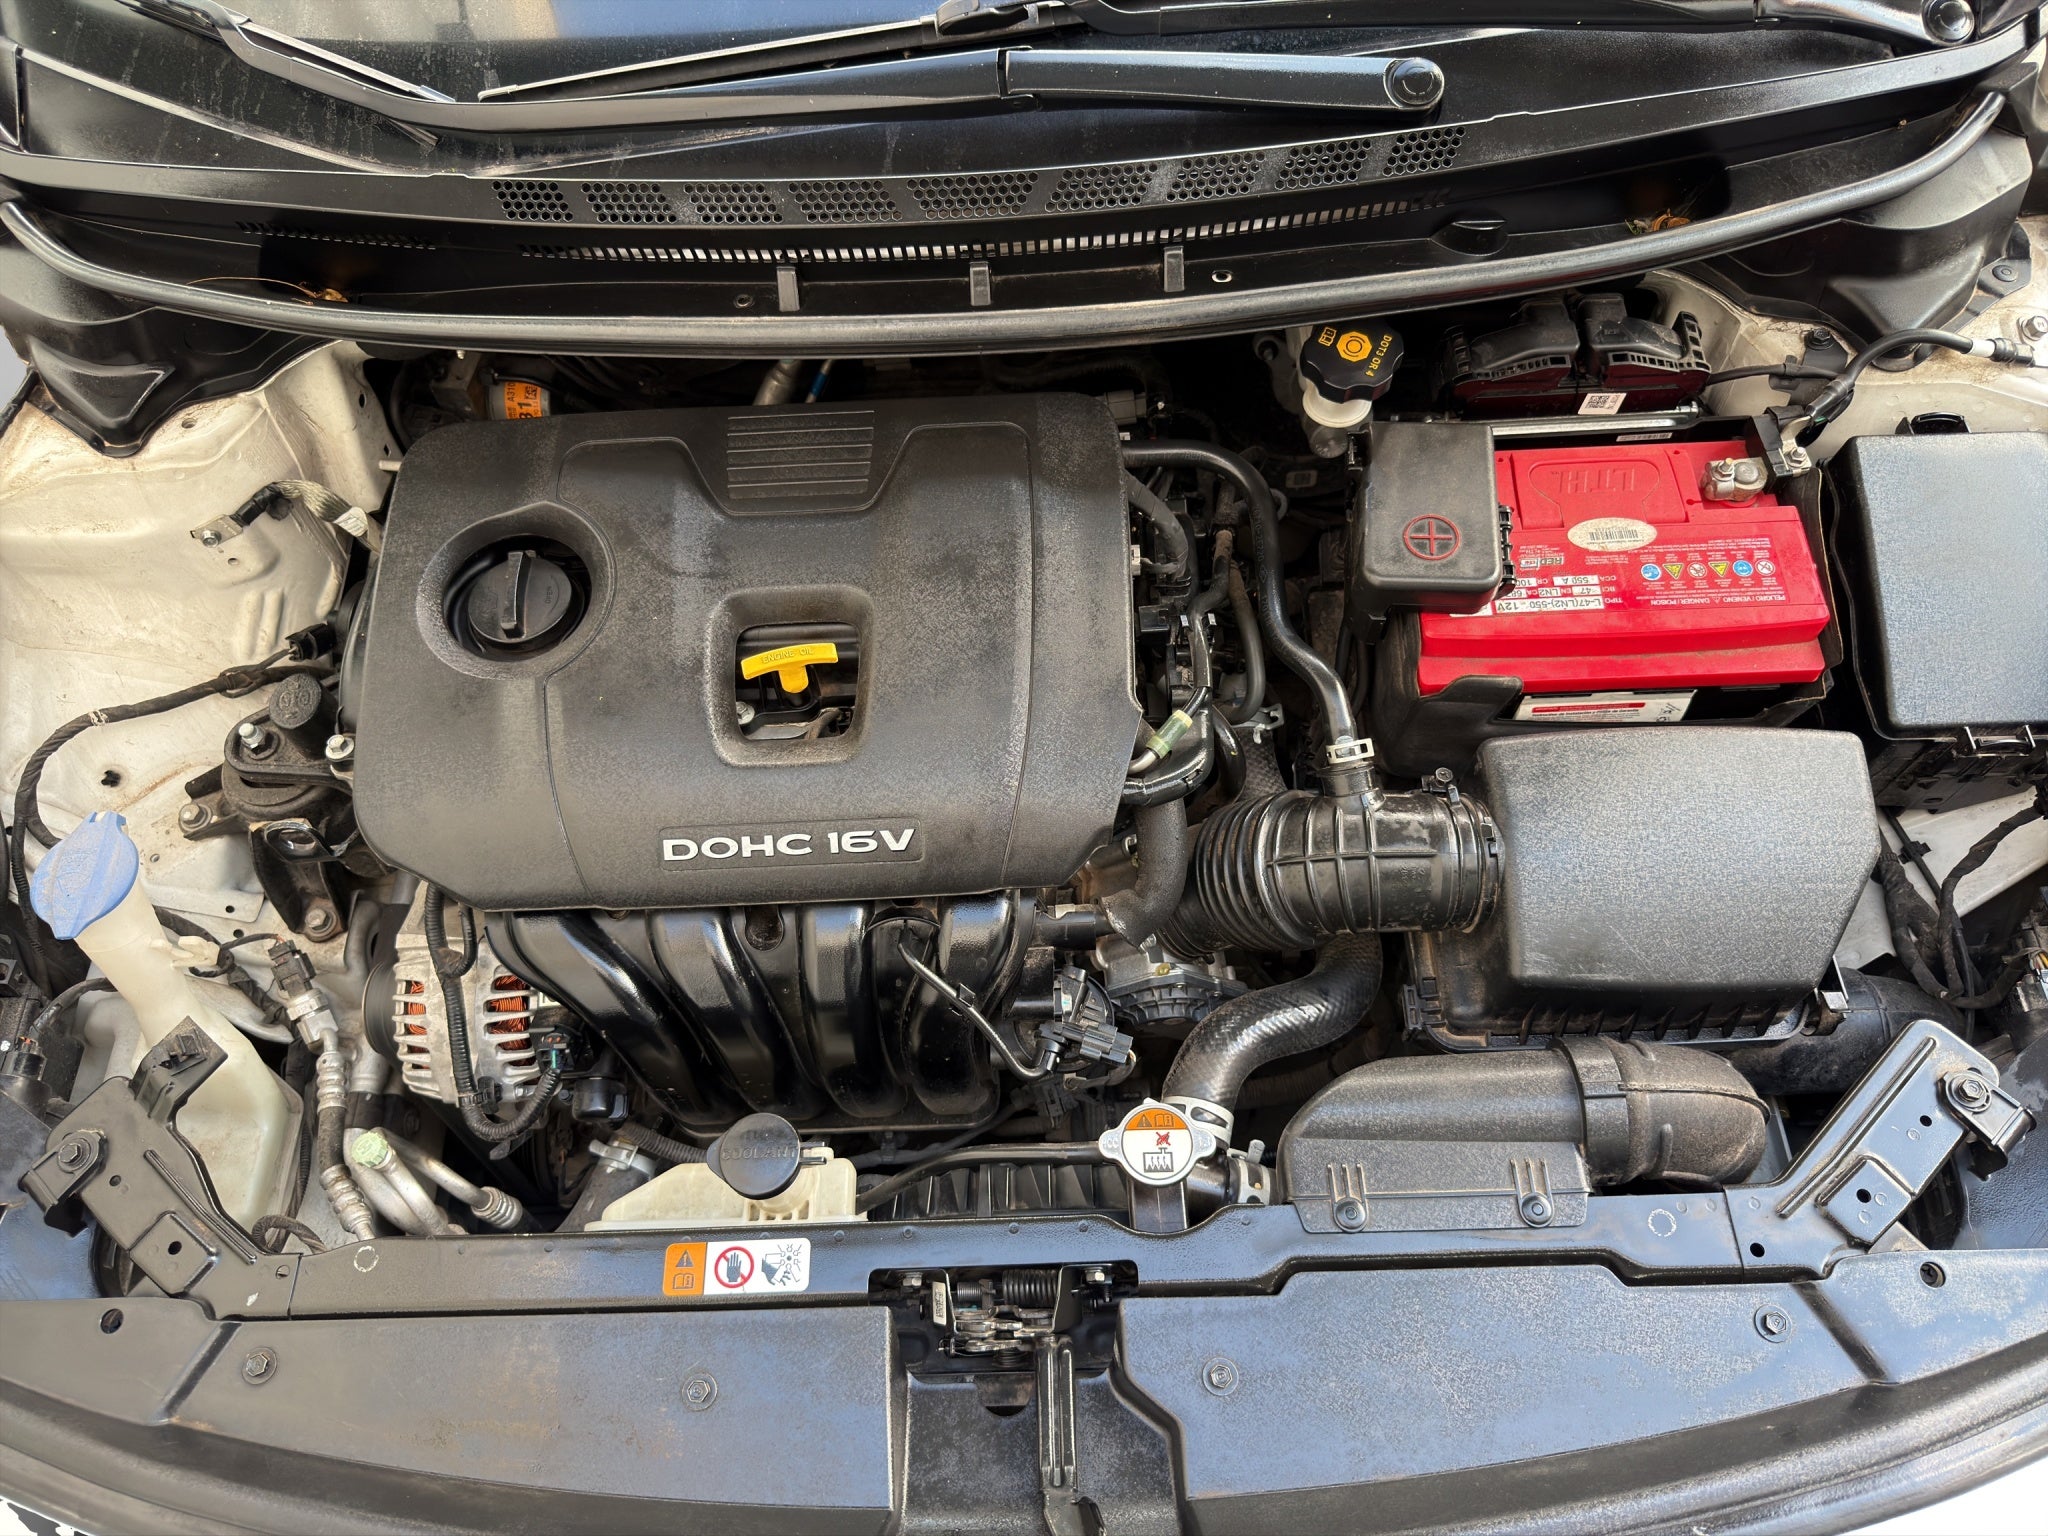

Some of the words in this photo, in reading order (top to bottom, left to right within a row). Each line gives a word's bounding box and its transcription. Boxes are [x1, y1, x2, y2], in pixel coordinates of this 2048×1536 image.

[1375, 335, 1392, 356] DOT3
[1369, 357, 1380, 369] OR
[1497, 602, 1518, 611] 12V
[761, 649, 796, 664] ENGINE
[799, 647, 814, 656] OIL
[662, 833, 813, 861] DOHC
[827, 828, 915, 854] 16V
[721, 1145, 797, 1160] COOLANT
